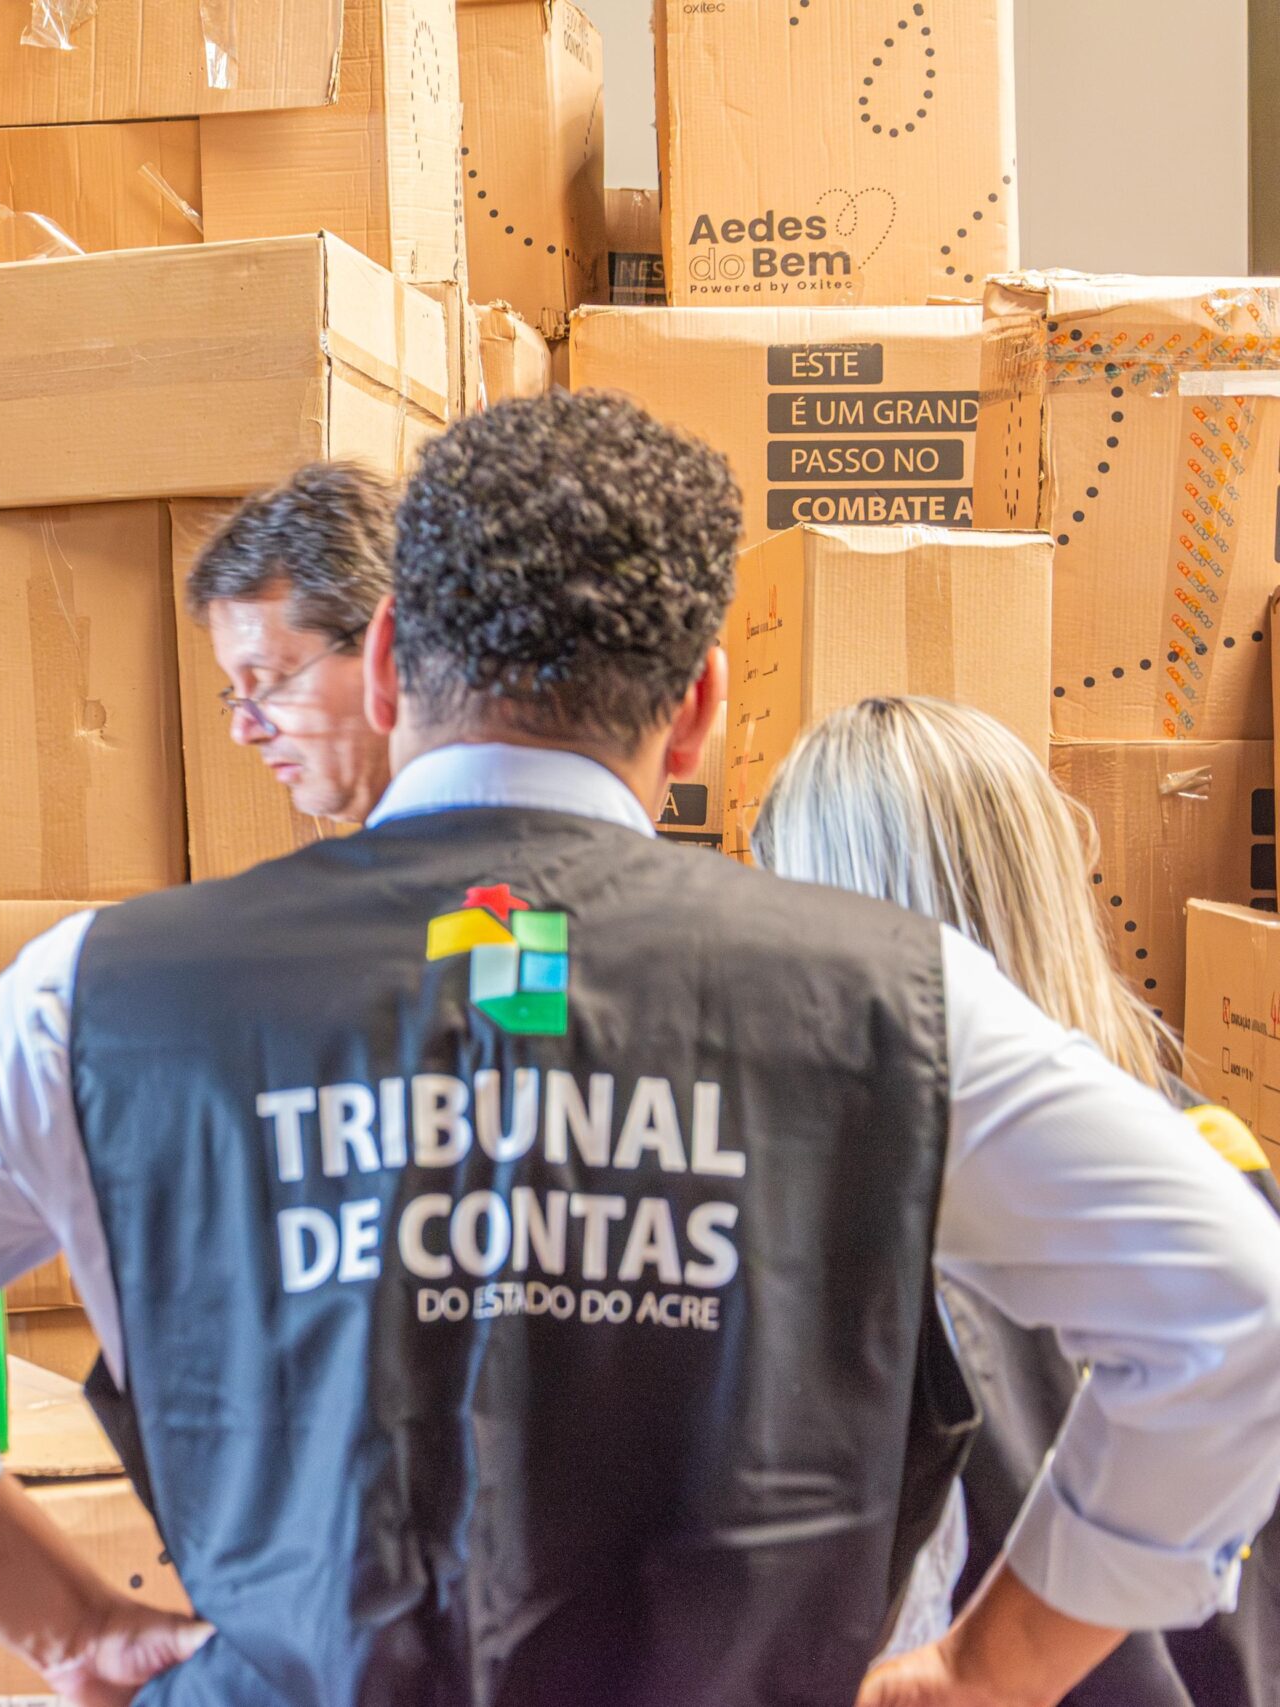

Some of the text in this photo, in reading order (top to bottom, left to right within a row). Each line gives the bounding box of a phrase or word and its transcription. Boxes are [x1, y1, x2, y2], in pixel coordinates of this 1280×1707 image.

[683, 2, 726, 14] oxitec
[688, 209, 827, 246] Aedes
[688, 247, 852, 281] do Bem
[690, 279, 853, 294] Powered by Oxitec
[791, 351, 859, 378] ESTE
[792, 396, 979, 426] É UM GRAND
[791, 447, 939, 474] PASSO NO
[792, 495, 973, 522] COMBATE A
[256, 1067, 746, 1182] TRIBUNAL
[277, 1186, 739, 1293] DE CONTAS
[417, 1280, 720, 1331] DO ESTADO DO ACRE
